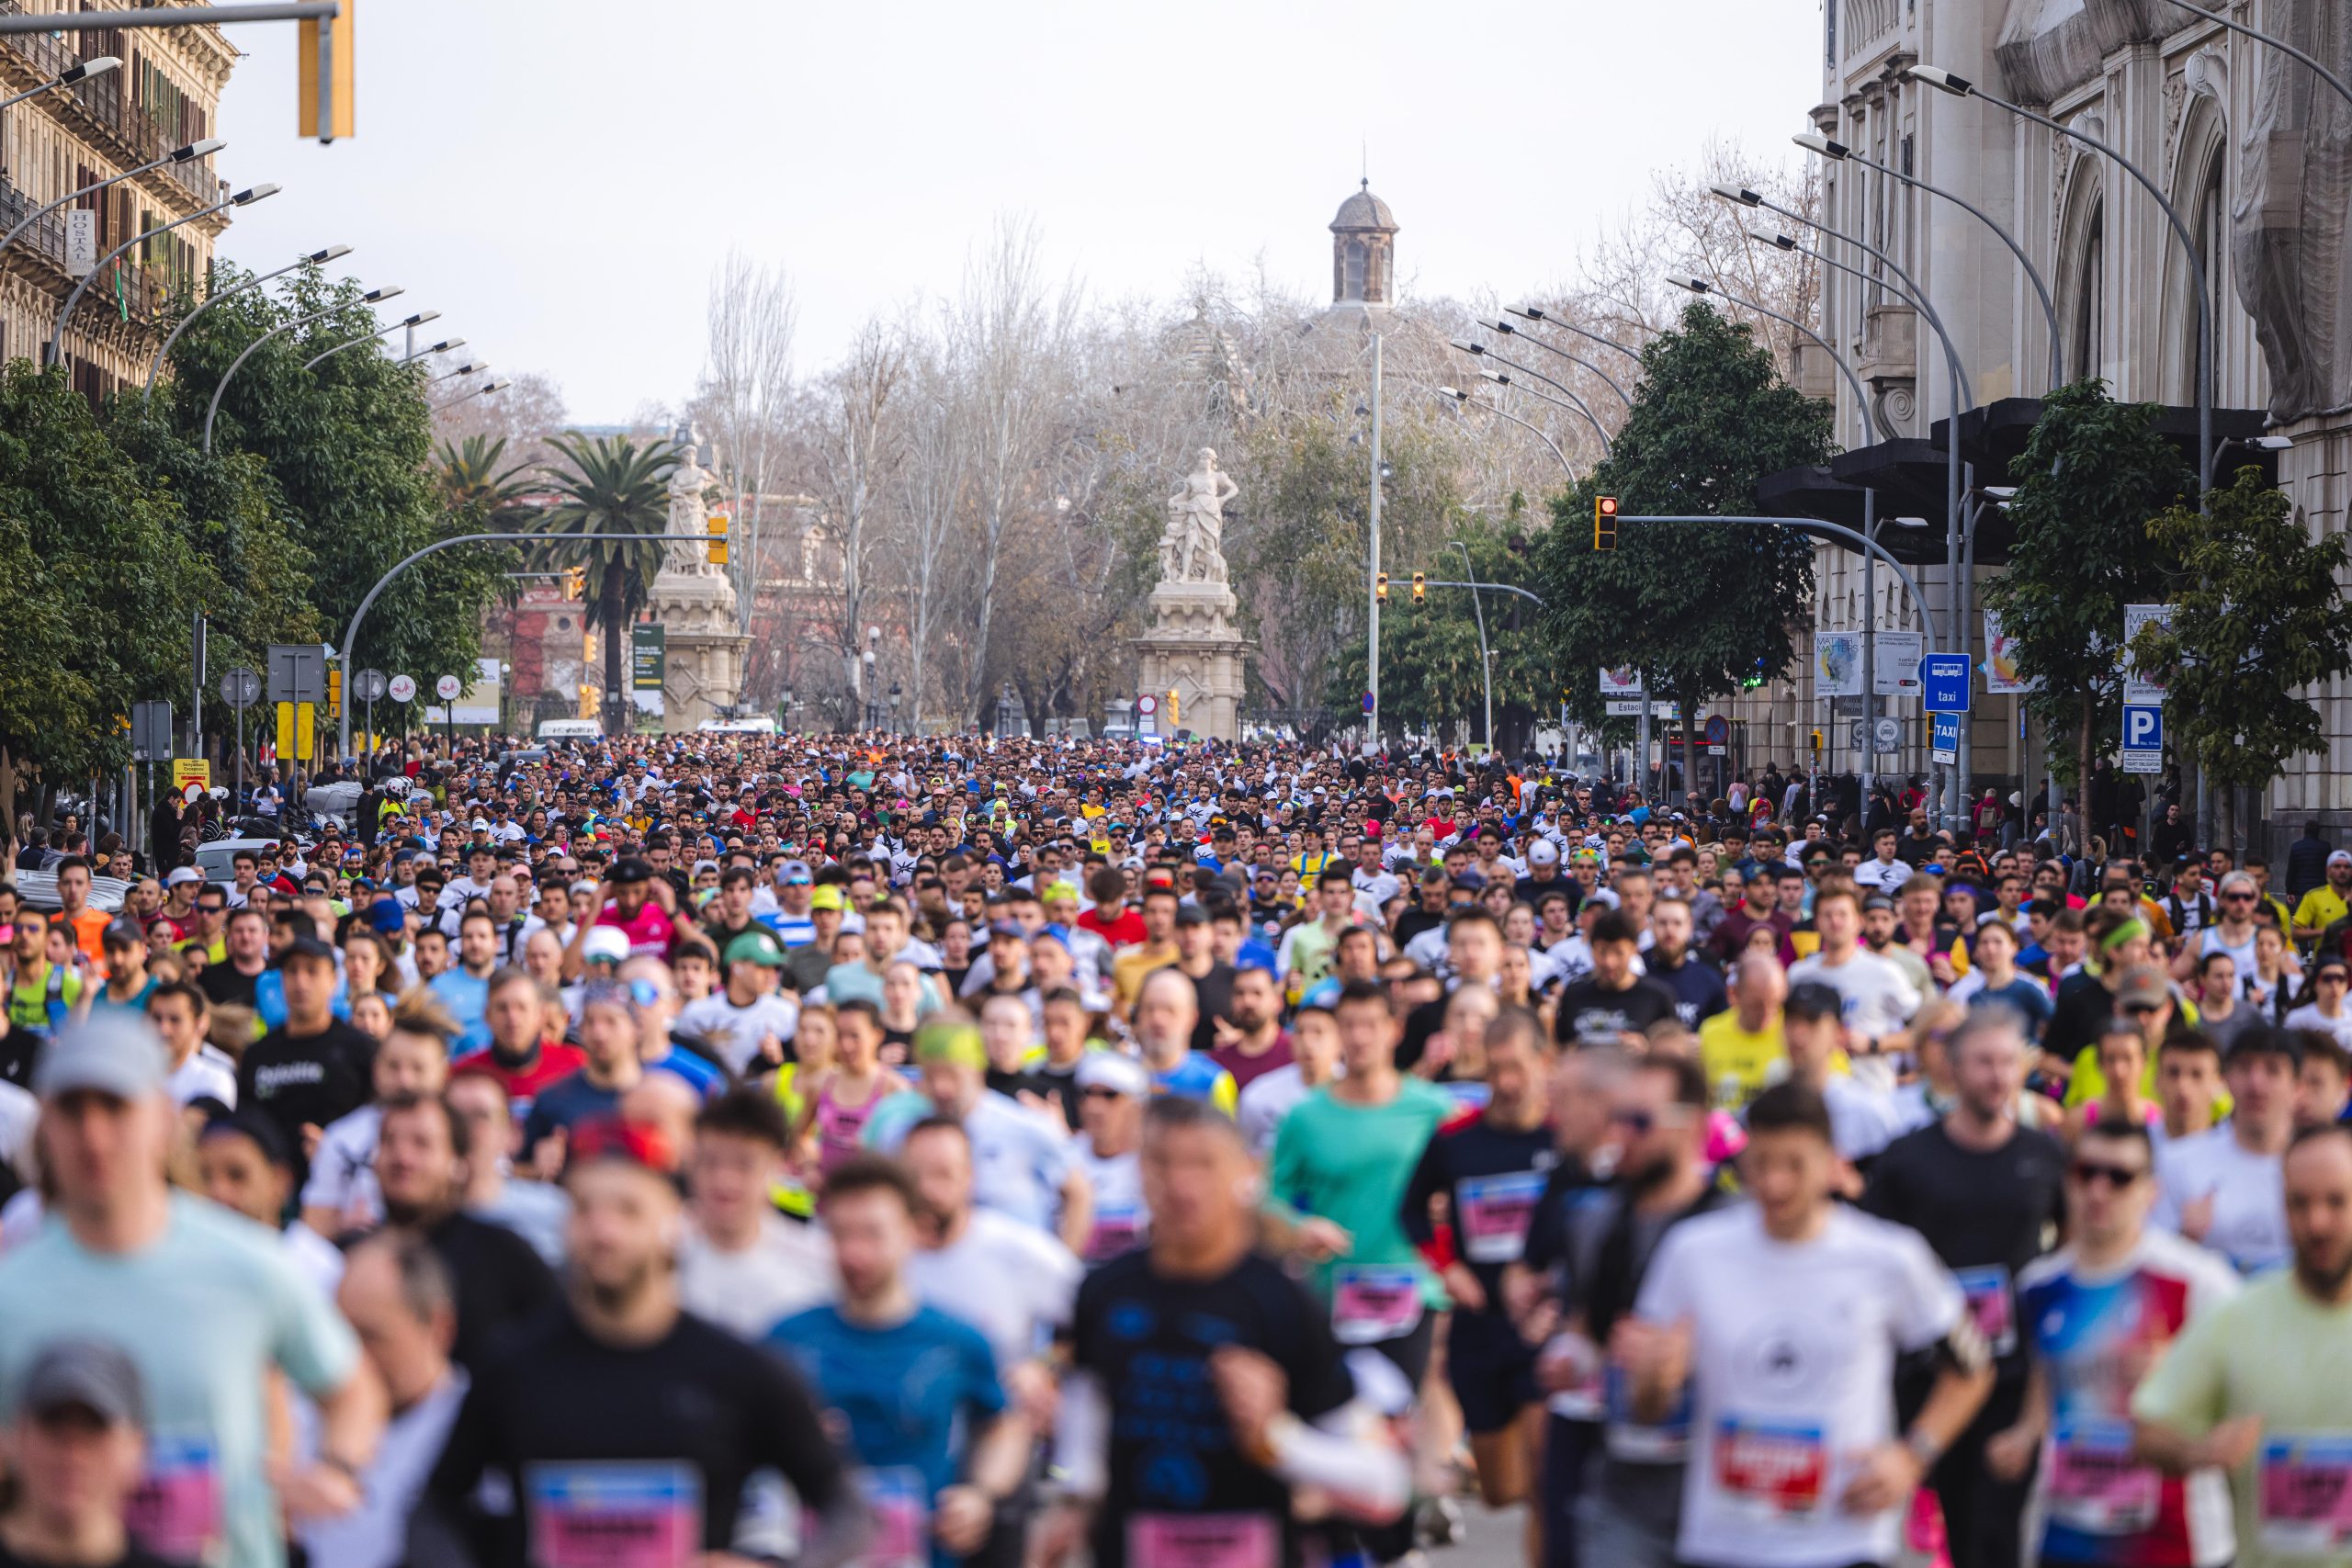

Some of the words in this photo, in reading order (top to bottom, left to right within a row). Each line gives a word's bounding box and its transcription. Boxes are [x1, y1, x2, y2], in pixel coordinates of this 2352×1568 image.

[74, 214, 87, 260] HOSTAL
[1817, 637, 1852, 645] MATTER
[1817, 645, 1859, 653] MATTERS
[1938, 691, 1956, 702] taxi
[1618, 703, 1643, 712] Estaci
[1937, 725, 1956, 739] TAXI
[2131, 710, 2154, 745] P
